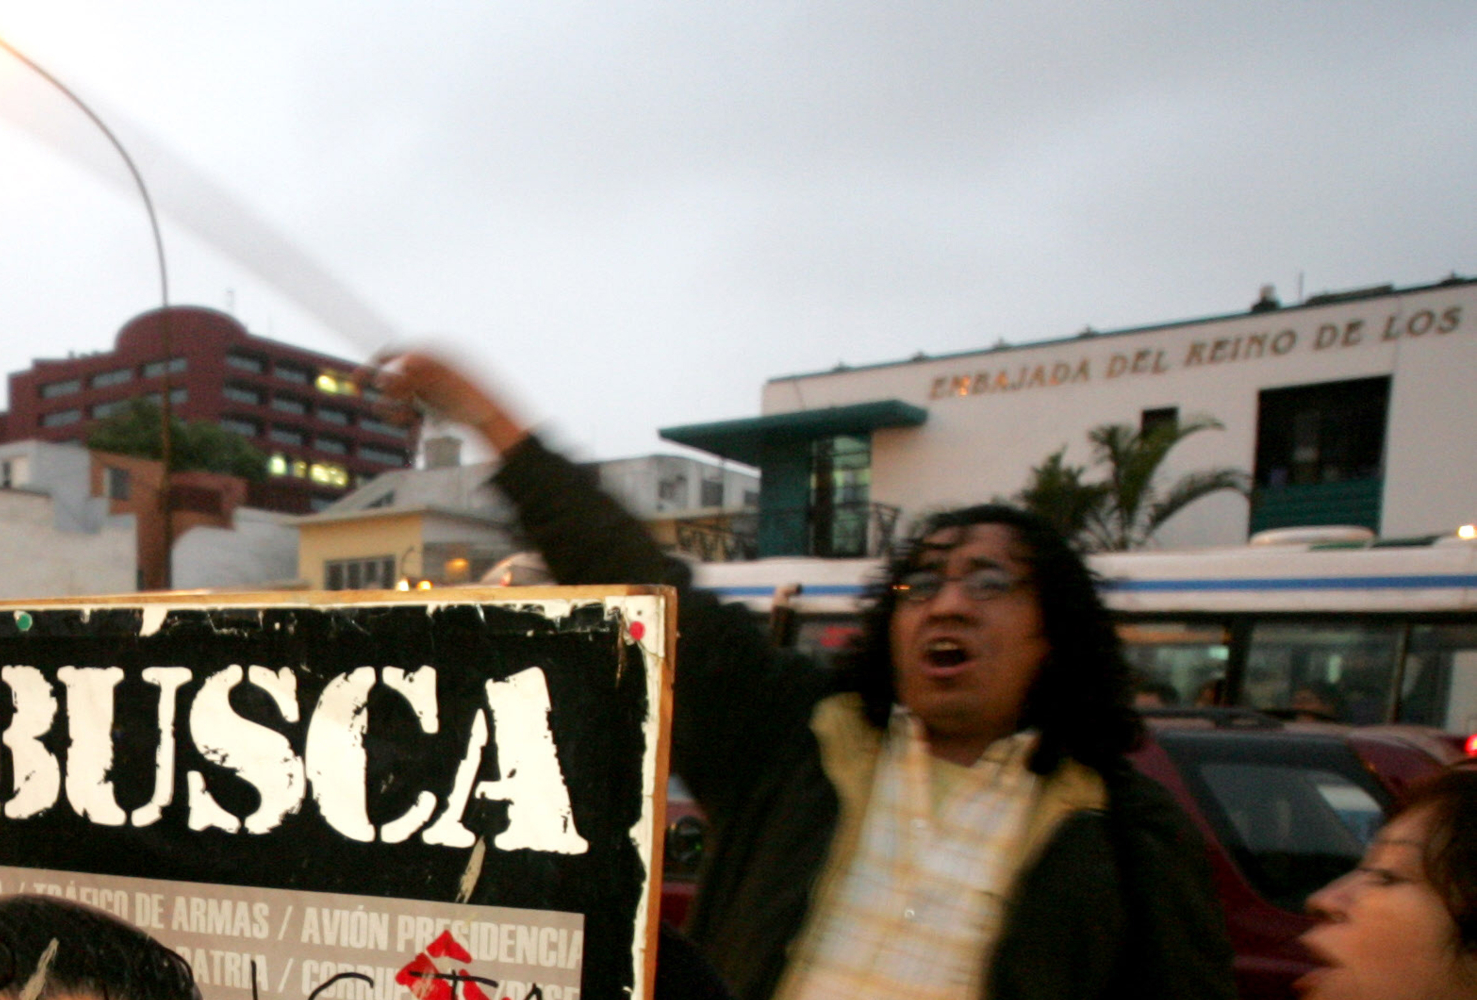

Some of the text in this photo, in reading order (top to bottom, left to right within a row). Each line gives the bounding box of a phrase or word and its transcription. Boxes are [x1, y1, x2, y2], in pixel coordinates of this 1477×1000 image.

[928, 305, 1462, 401] EMBAJADA DEL REINO DE LOS
[134, 891, 165, 930] DE
[171, 895, 270, 940] ARMAS
[300, 904, 390, 952] AVIÓN
